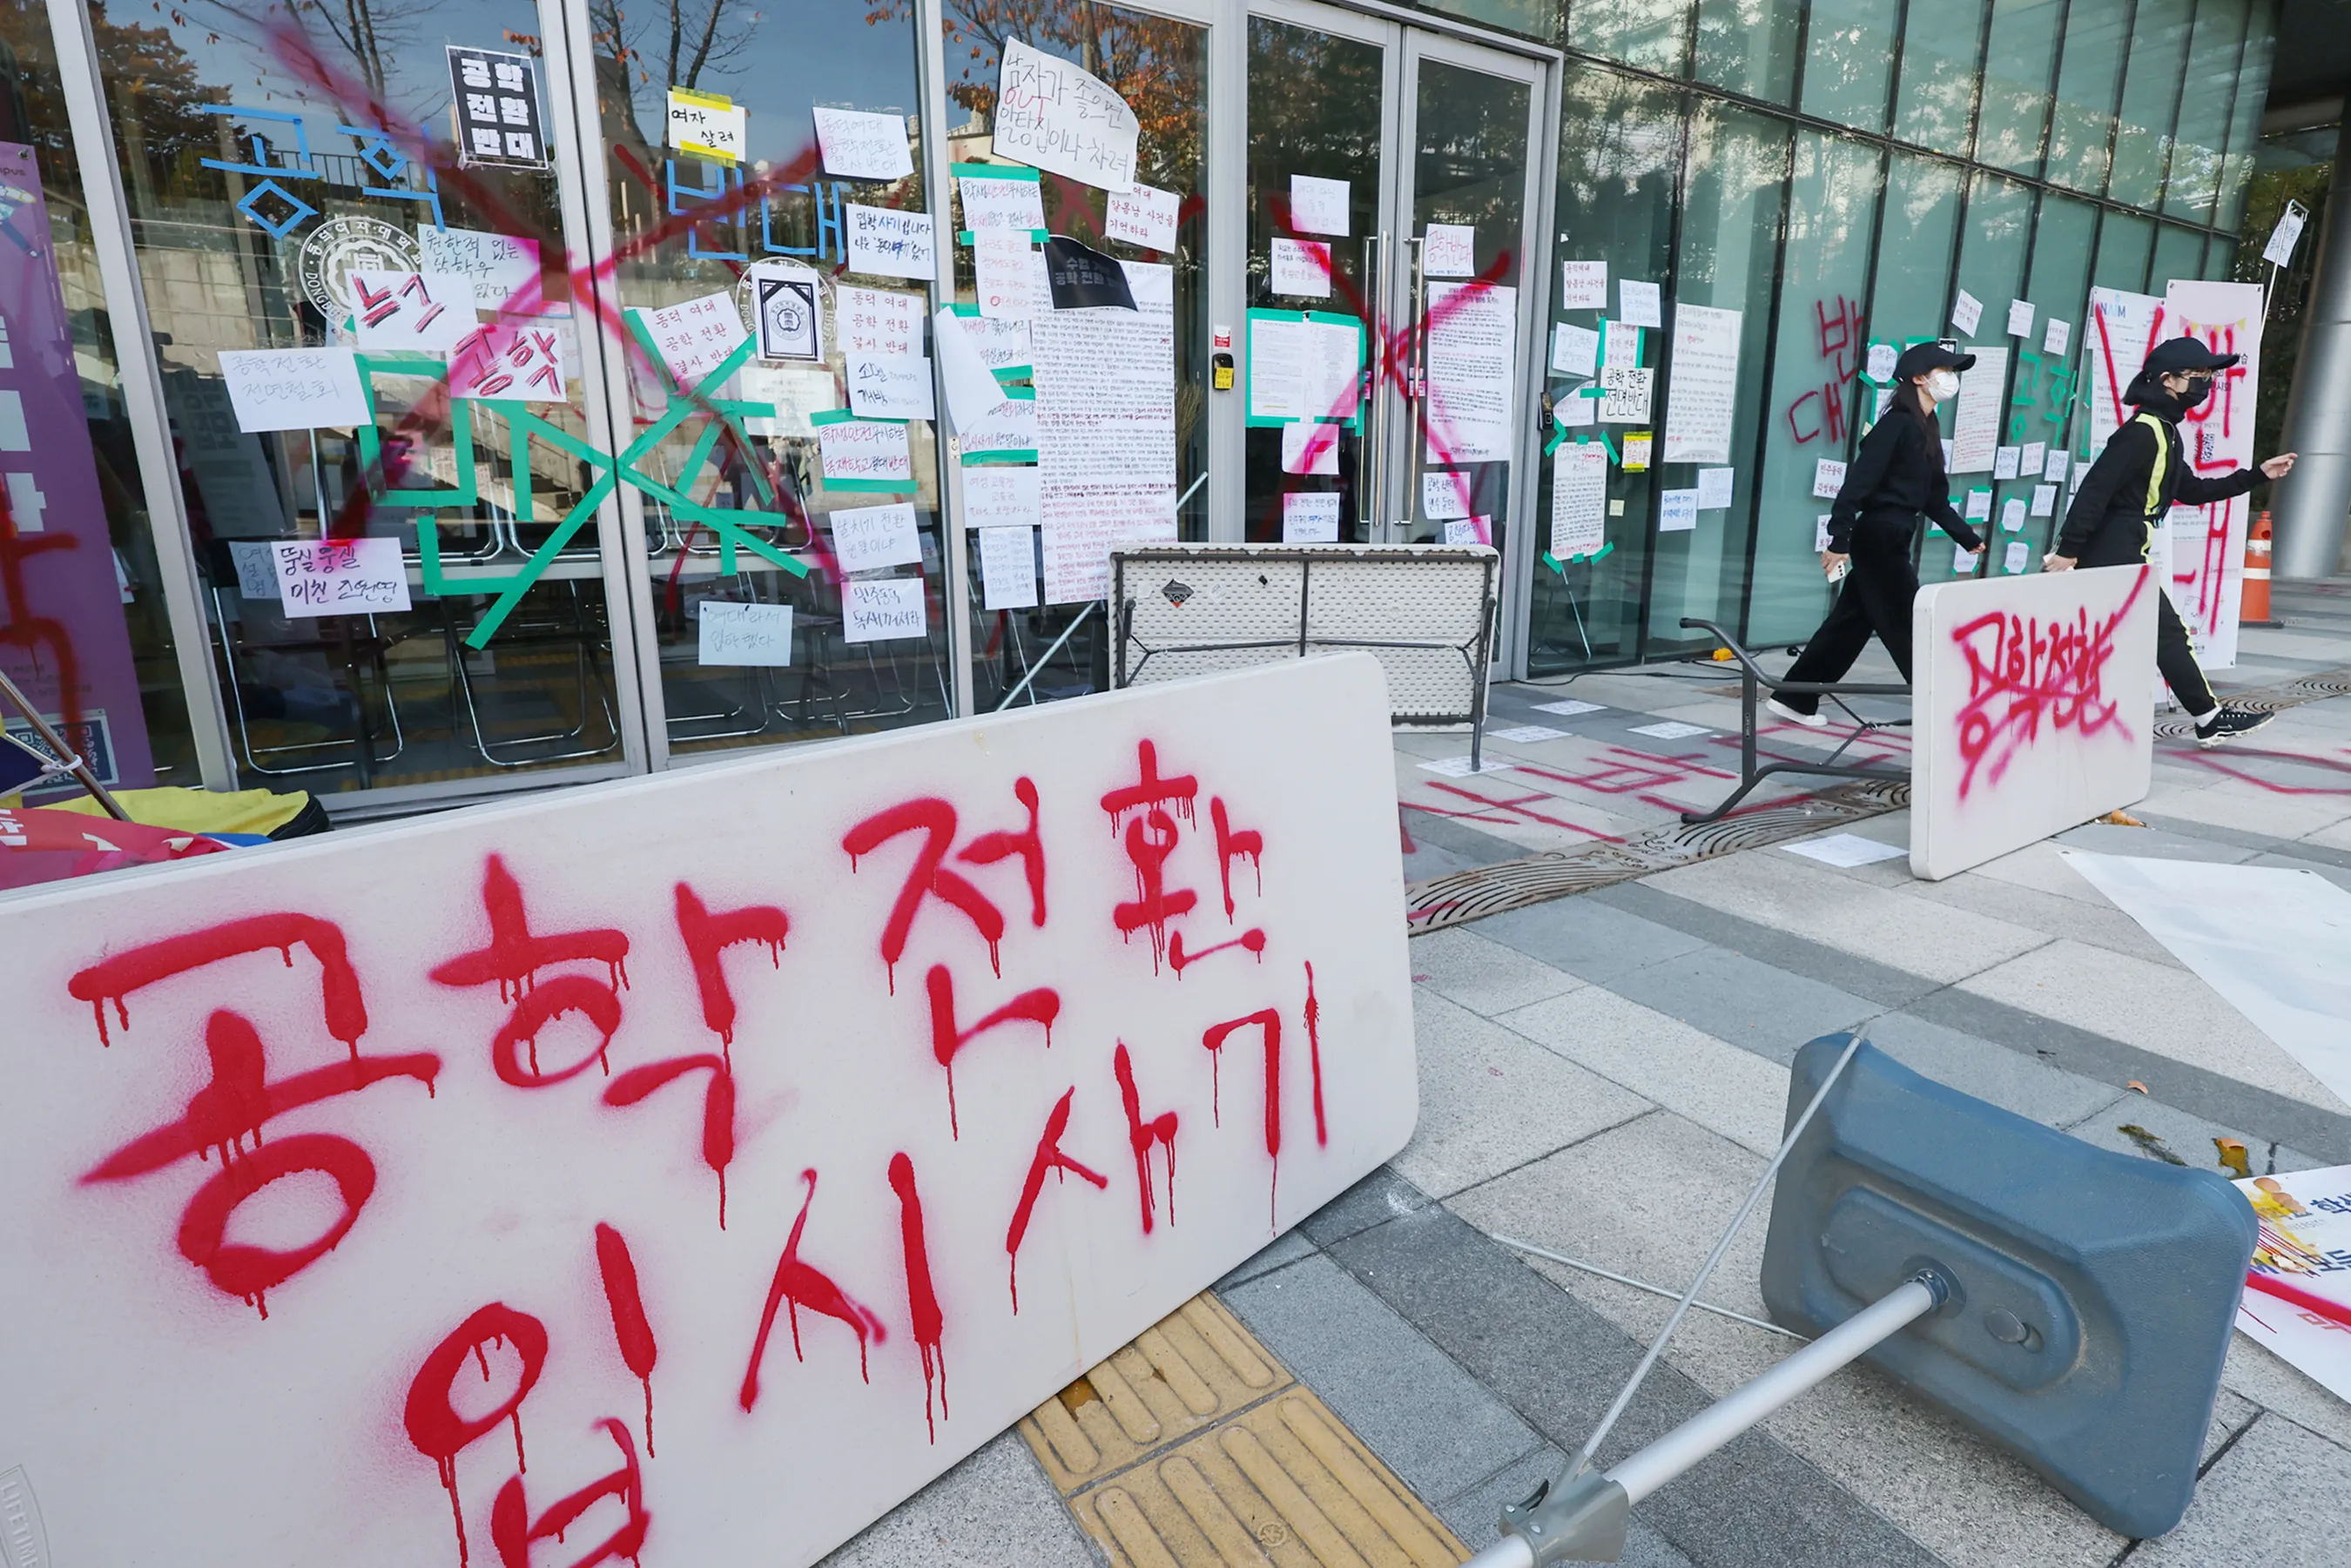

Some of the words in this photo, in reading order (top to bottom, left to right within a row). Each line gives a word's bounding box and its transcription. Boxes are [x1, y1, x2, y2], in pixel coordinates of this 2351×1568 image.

[461, 57, 524, 92] 공학
[1007, 52, 1069, 106] 남자가
[465, 93, 531, 126] 전환
[671, 109, 706, 125] 여자
[821, 114, 883, 132] 동덕여대
[471, 126, 536, 161] 반대
[700, 130, 734, 148] 살려
[825, 138, 899, 156] 공학전환
[1111, 199, 1141, 218] 알몸남
[1146, 209, 1175, 227] 사건을
[1108, 219, 1149, 238] 기억하라
[1054, 271, 1078, 286] 공학
[656, 309, 683, 329] 동덕
[690, 299, 717, 317] 여대
[852, 293, 876, 306] 동덕
[884, 297, 907, 311] 여대
[852, 313, 878, 329] 공학
[886, 319, 910, 333] 전환
[665, 333, 693, 352] 공학
[700, 322, 727, 341] 전환
[852, 335, 877, 351] 결사
[886, 340, 908, 354] 반대
[674, 355, 704, 375] 결사
[1789, 294, 1863, 444] 반대
[1607, 367, 1625, 387] 공학
[1627, 369, 1647, 390] 전환
[1605, 387, 1649, 417] 전면반대
[837, 516, 875, 538] 날치기
[880, 512, 906, 532] 전환
[291, 578, 330, 605] 미친
[853, 586, 900, 606] 민주동덕
[68, 853, 788, 1320] 공학
[843, 738, 1264, 1141] 전환
